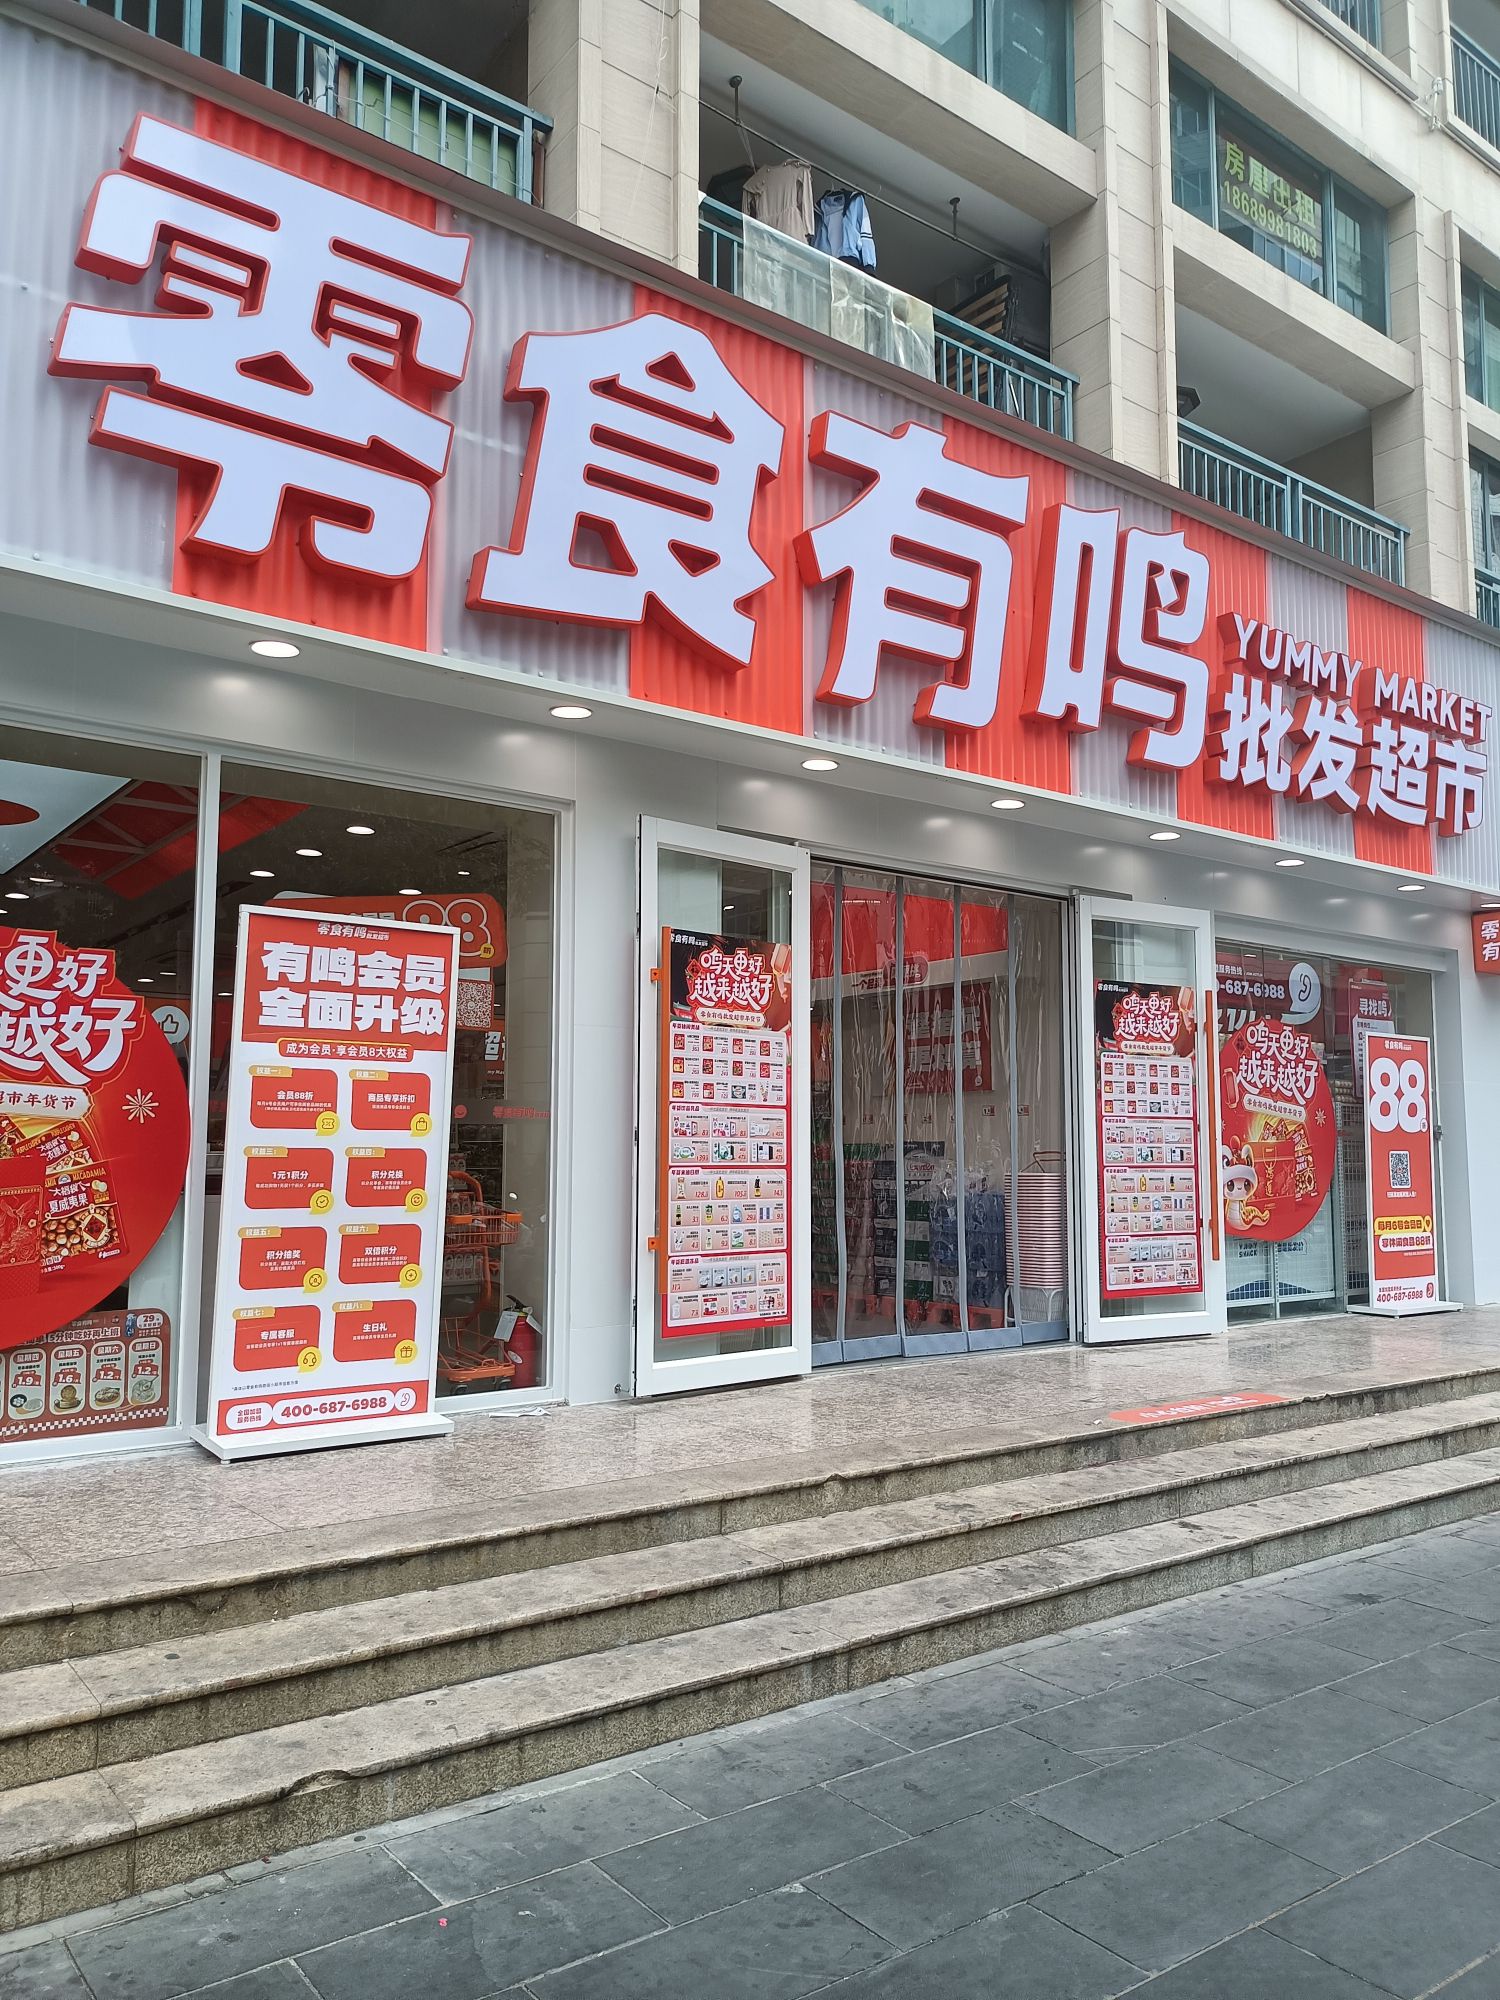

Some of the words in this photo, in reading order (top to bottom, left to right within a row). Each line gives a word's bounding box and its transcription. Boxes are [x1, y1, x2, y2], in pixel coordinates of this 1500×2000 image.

[1225, 141, 1316, 229] 房屋出租
[1224, 181, 1317, 259] 18689981803
[48, 112, 1210, 770] 零食有鸣
[1234, 613, 1363, 698] YUMMY
[1374, 667, 1493, 741] MARKET
[1220, 672, 1487, 834] 批发超市
[317, 921, 367, 938] 零食有鸣
[0, 935, 107, 1010] 更好
[261, 942, 446, 994] 有鸣会员
[701, 948, 763, 981] 鸣天更好
[690, 973, 773, 1011] 越来越好
[258, 987, 445, 1036] 全面升级
[1123, 994, 1172, 1018] 鸣天更好
[1115, 1013, 1180, 1042] 越来越好
[286, 1042, 407, 1059] 成为会员·享会员8大权益
[1246, 1021, 1310, 1063] 鸣天更好
[1236, 1050, 1319, 1105] 越来越好
[0, 1092, 77, 1110] 市年货节
[277, 1090, 314, 1101] 会员88折
[368, 1093, 415, 1103] 商品专享折扣
[1370, 1057, 1427, 1132] 88
[272, 1170, 309, 1181] 1元1积分
[371, 1170, 404, 1179] 积分兑换
[49, 1193, 88, 1214] 夏威夷果
[266, 1250, 301, 1260] 积分抽奖
[364, 1246, 398, 1255] 双倍积分
[1376, 1290, 1423, 1303] 400-687-6988
[260, 1329, 295, 1340] 专属客服
[362, 1323, 388, 1332] 生日礼
[281, 1397, 387, 1418] 400-687-6988
